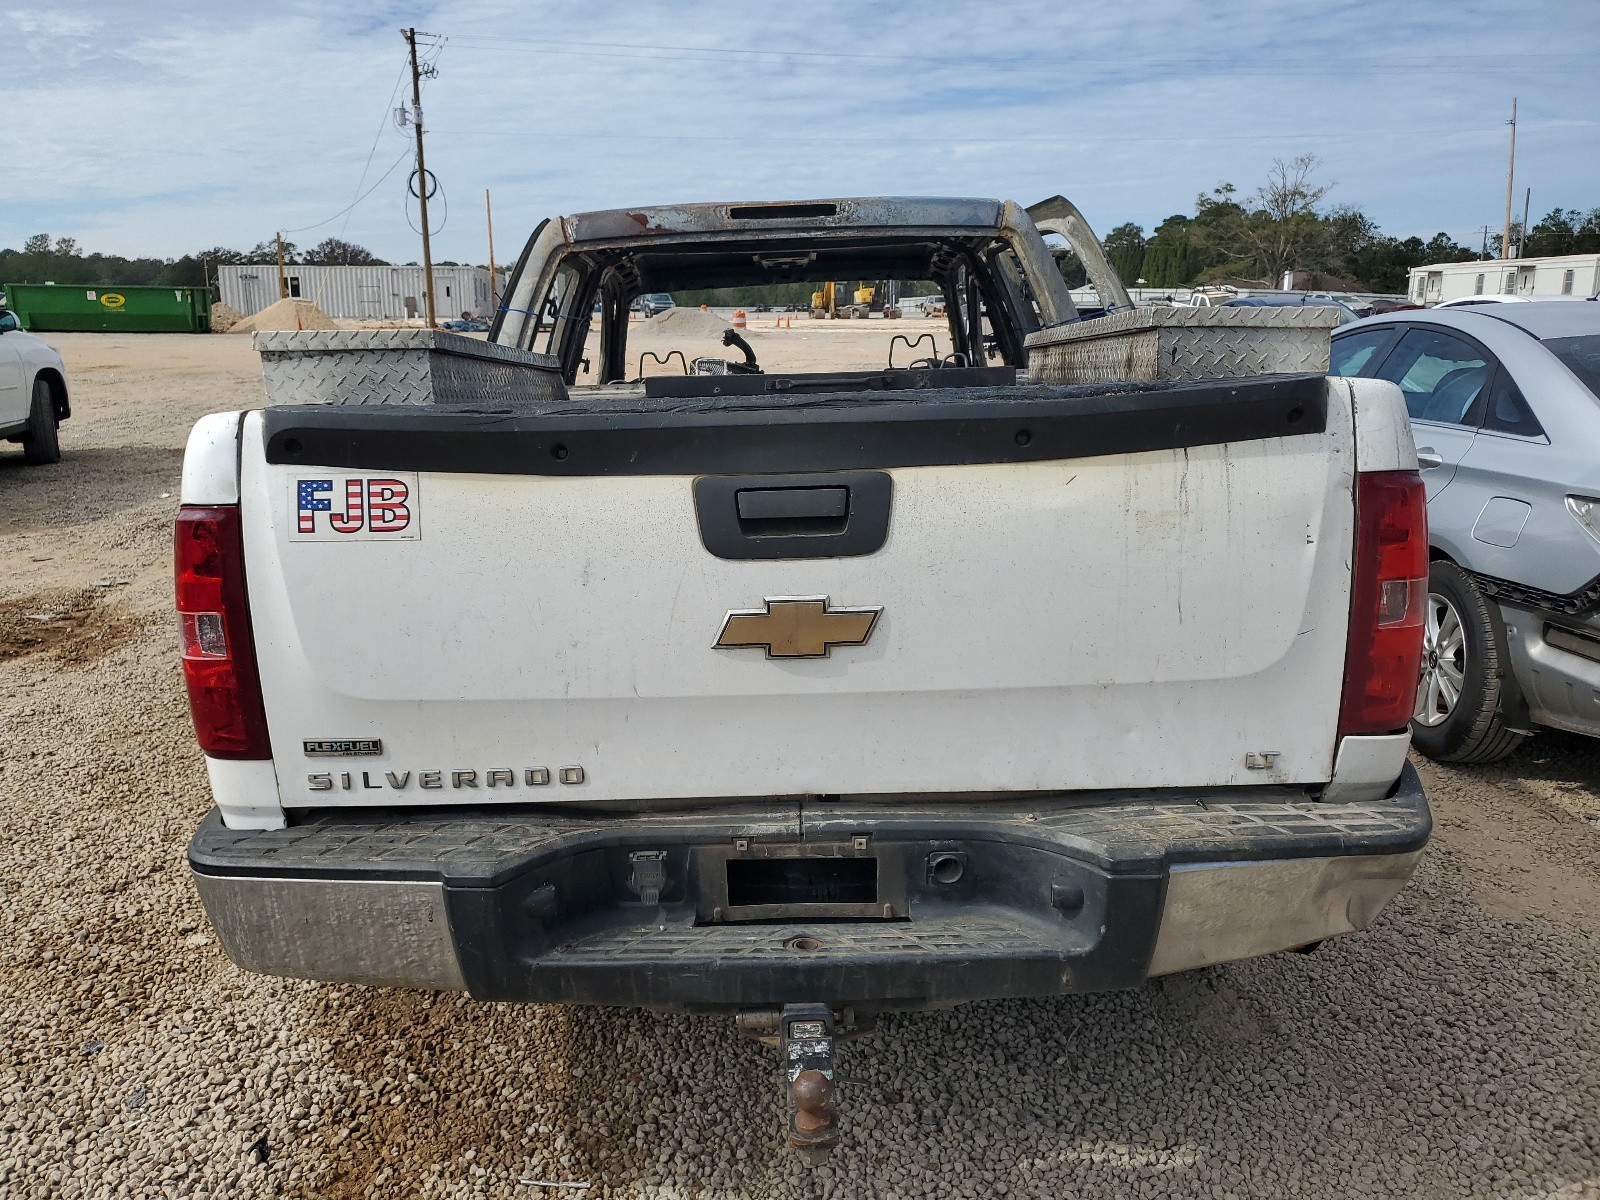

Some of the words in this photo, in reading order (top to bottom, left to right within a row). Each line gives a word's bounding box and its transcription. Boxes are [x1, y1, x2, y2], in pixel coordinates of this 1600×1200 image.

[297, 479, 411, 533] FJB
[306, 742, 378, 751] FLEXFUEL
[1245, 751, 1281, 770] LT
[308, 764, 585, 790] SILVERADO
